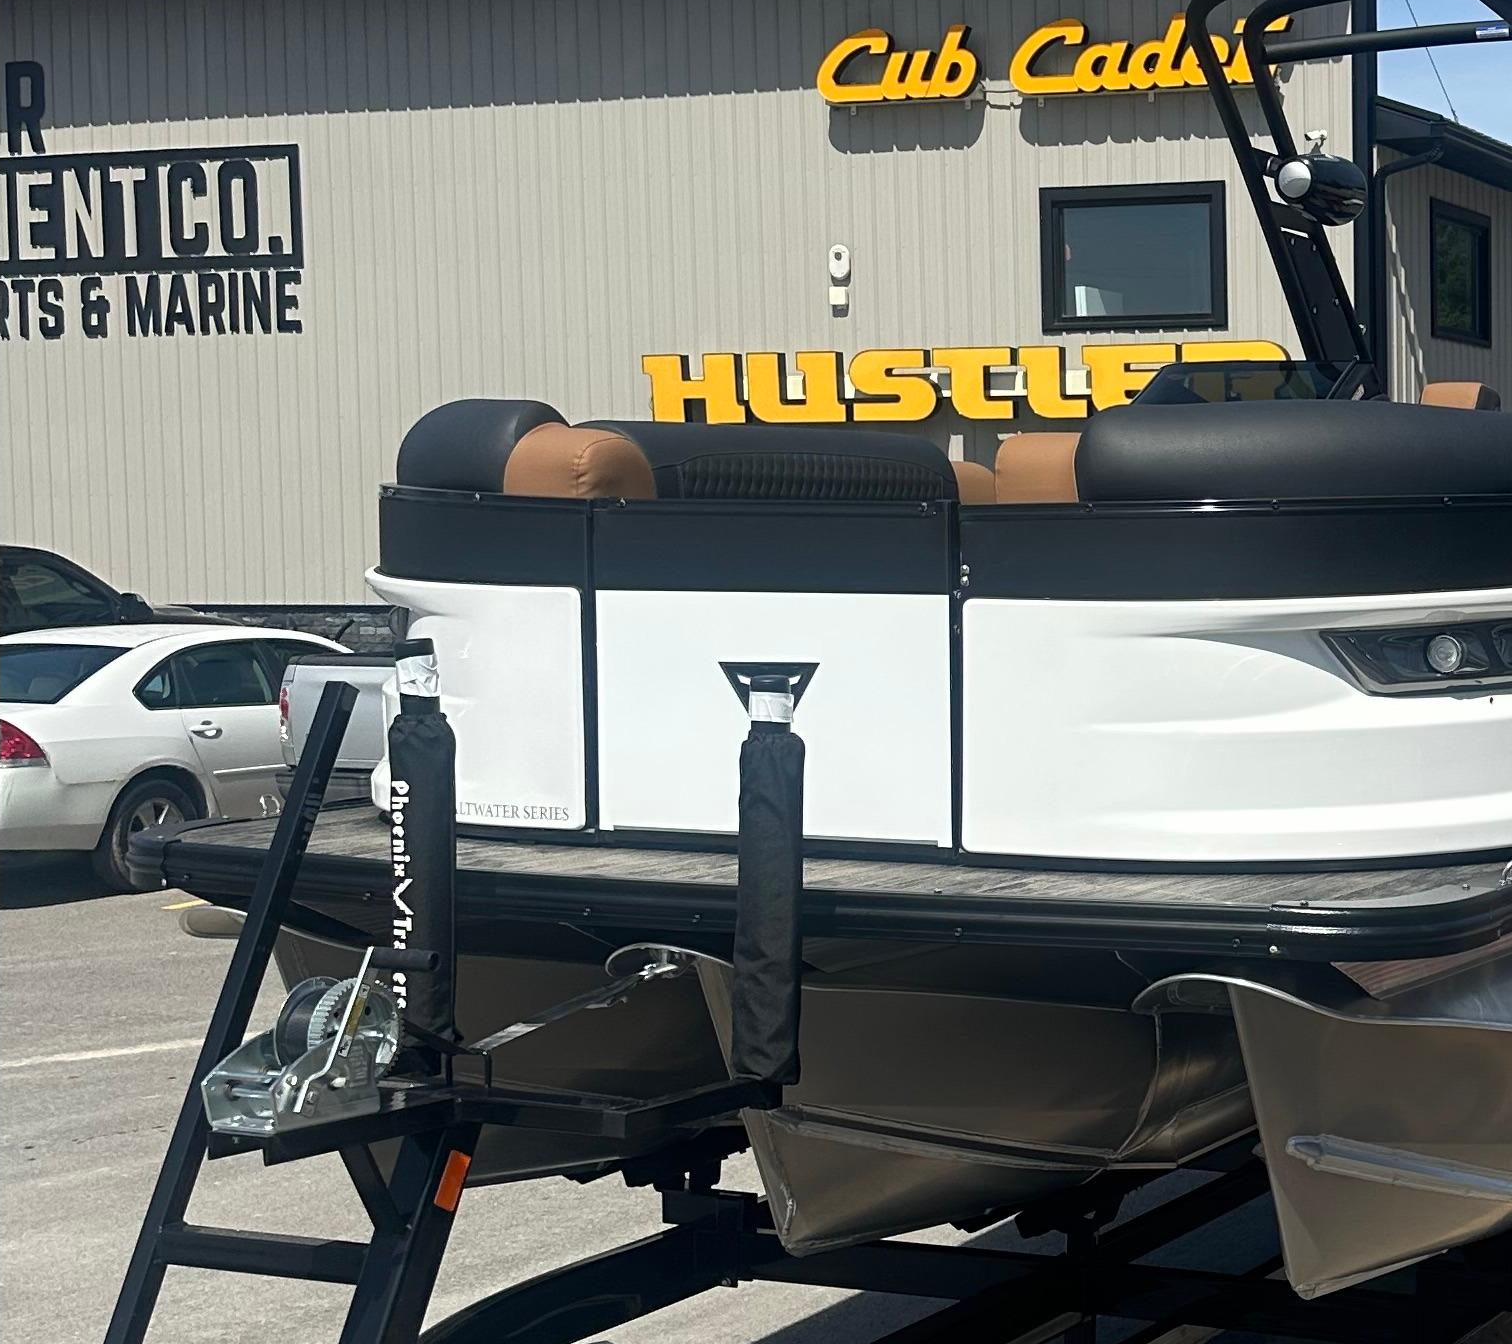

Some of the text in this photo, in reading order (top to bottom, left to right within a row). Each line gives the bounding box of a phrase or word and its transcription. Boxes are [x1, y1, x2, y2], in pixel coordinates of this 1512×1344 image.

[817, 24, 978, 102] Cub
[0, 157, 285, 261] ENT CO.
[80, 275, 111, 340] &
[125, 270, 303, 338] MARINE
[455, 802, 570, 821] LTWATER SERIES
[391, 780, 413, 1009] Phoenix Traers
